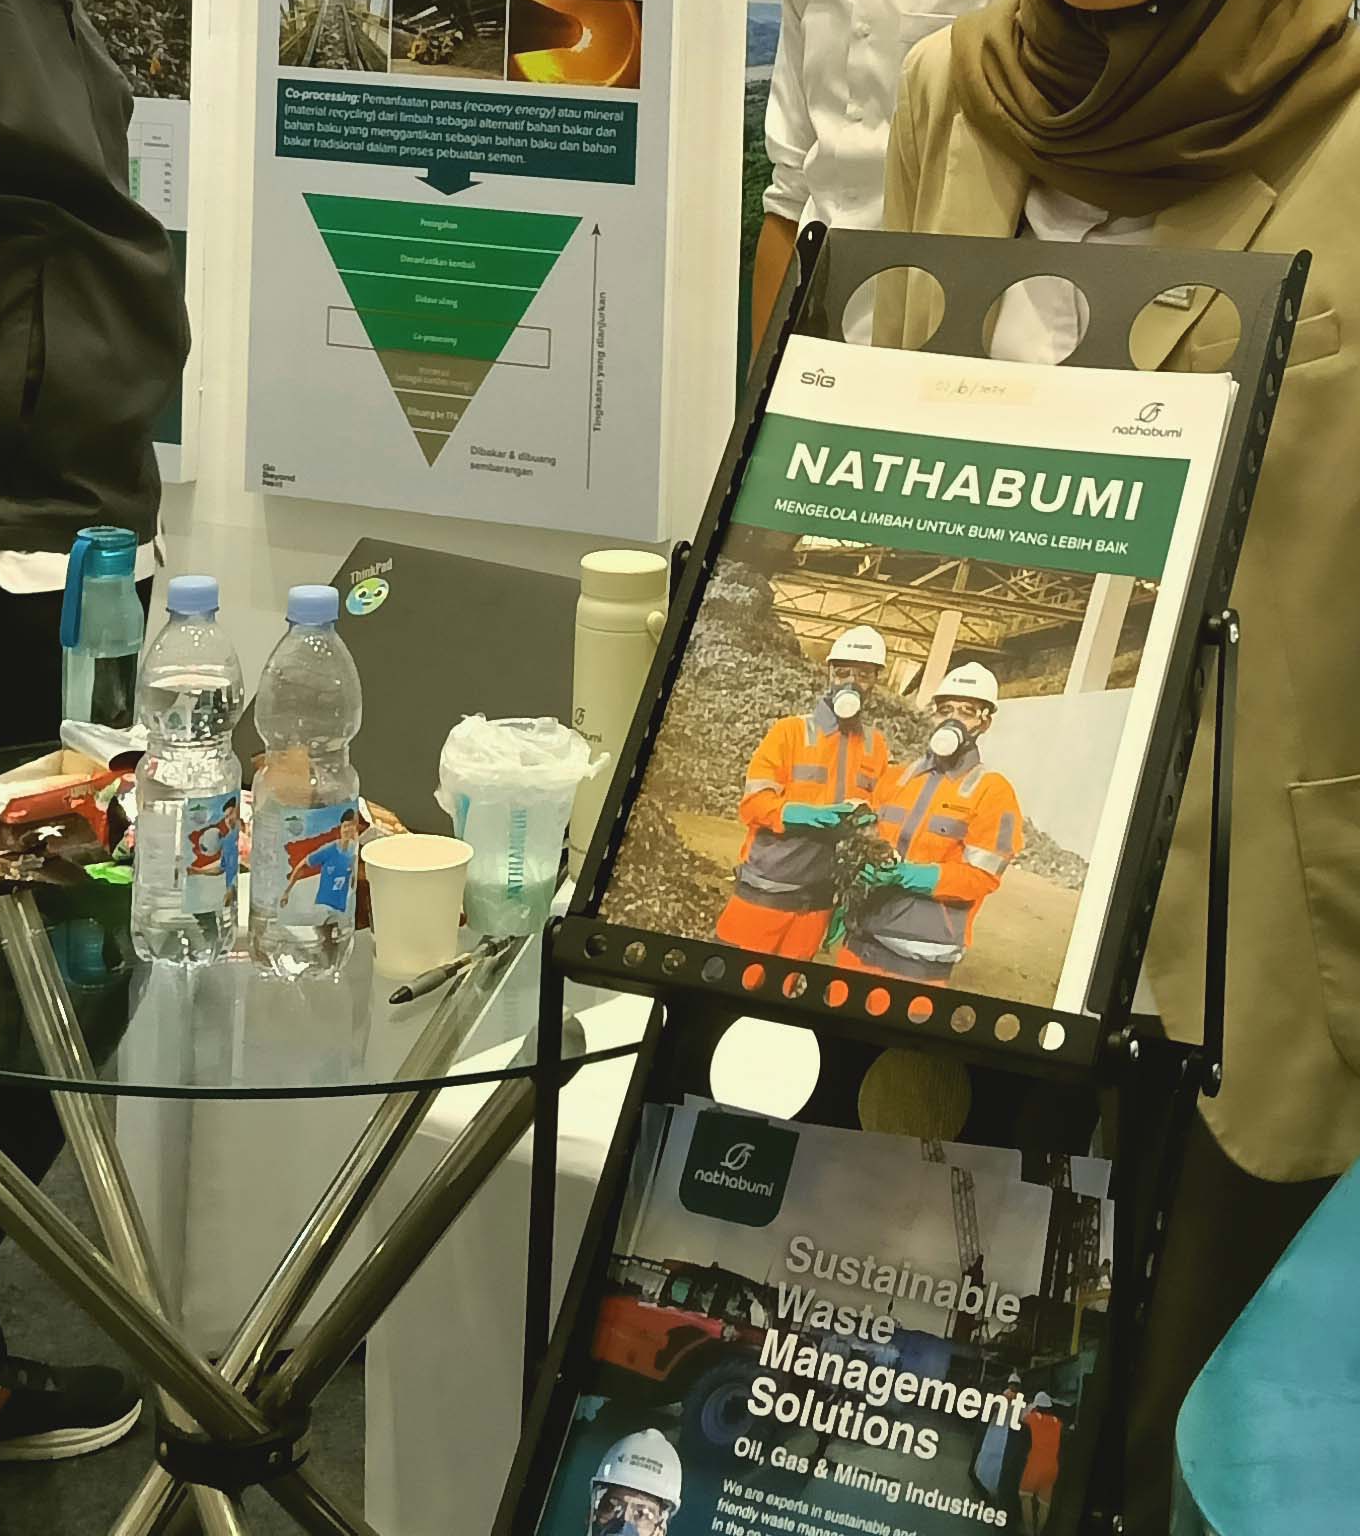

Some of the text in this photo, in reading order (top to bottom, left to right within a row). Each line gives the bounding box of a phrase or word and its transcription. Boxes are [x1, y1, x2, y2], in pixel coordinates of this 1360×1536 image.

[800, 369, 835, 388] SIG
[1111, 424, 1182, 439] nathabumi
[786, 442, 1144, 521] NATHABUMI
[774, 499, 1129, 555] MENGELOLA LIMBAH UNTUK BUMI YANG LEBIH BAIK
[350, 556, 392, 584] ThinkPad
[694, 1169, 774, 1198] nathabumi
[786, 1236, 1021, 1325] Sustainable
[777, 1281, 896, 1345] Waste
[758, 1329, 1026, 1431] Management
[747, 1376, 940, 1462] Solutions
[734, 1437, 1008, 1528] Oil, Gas & Mining Industries
